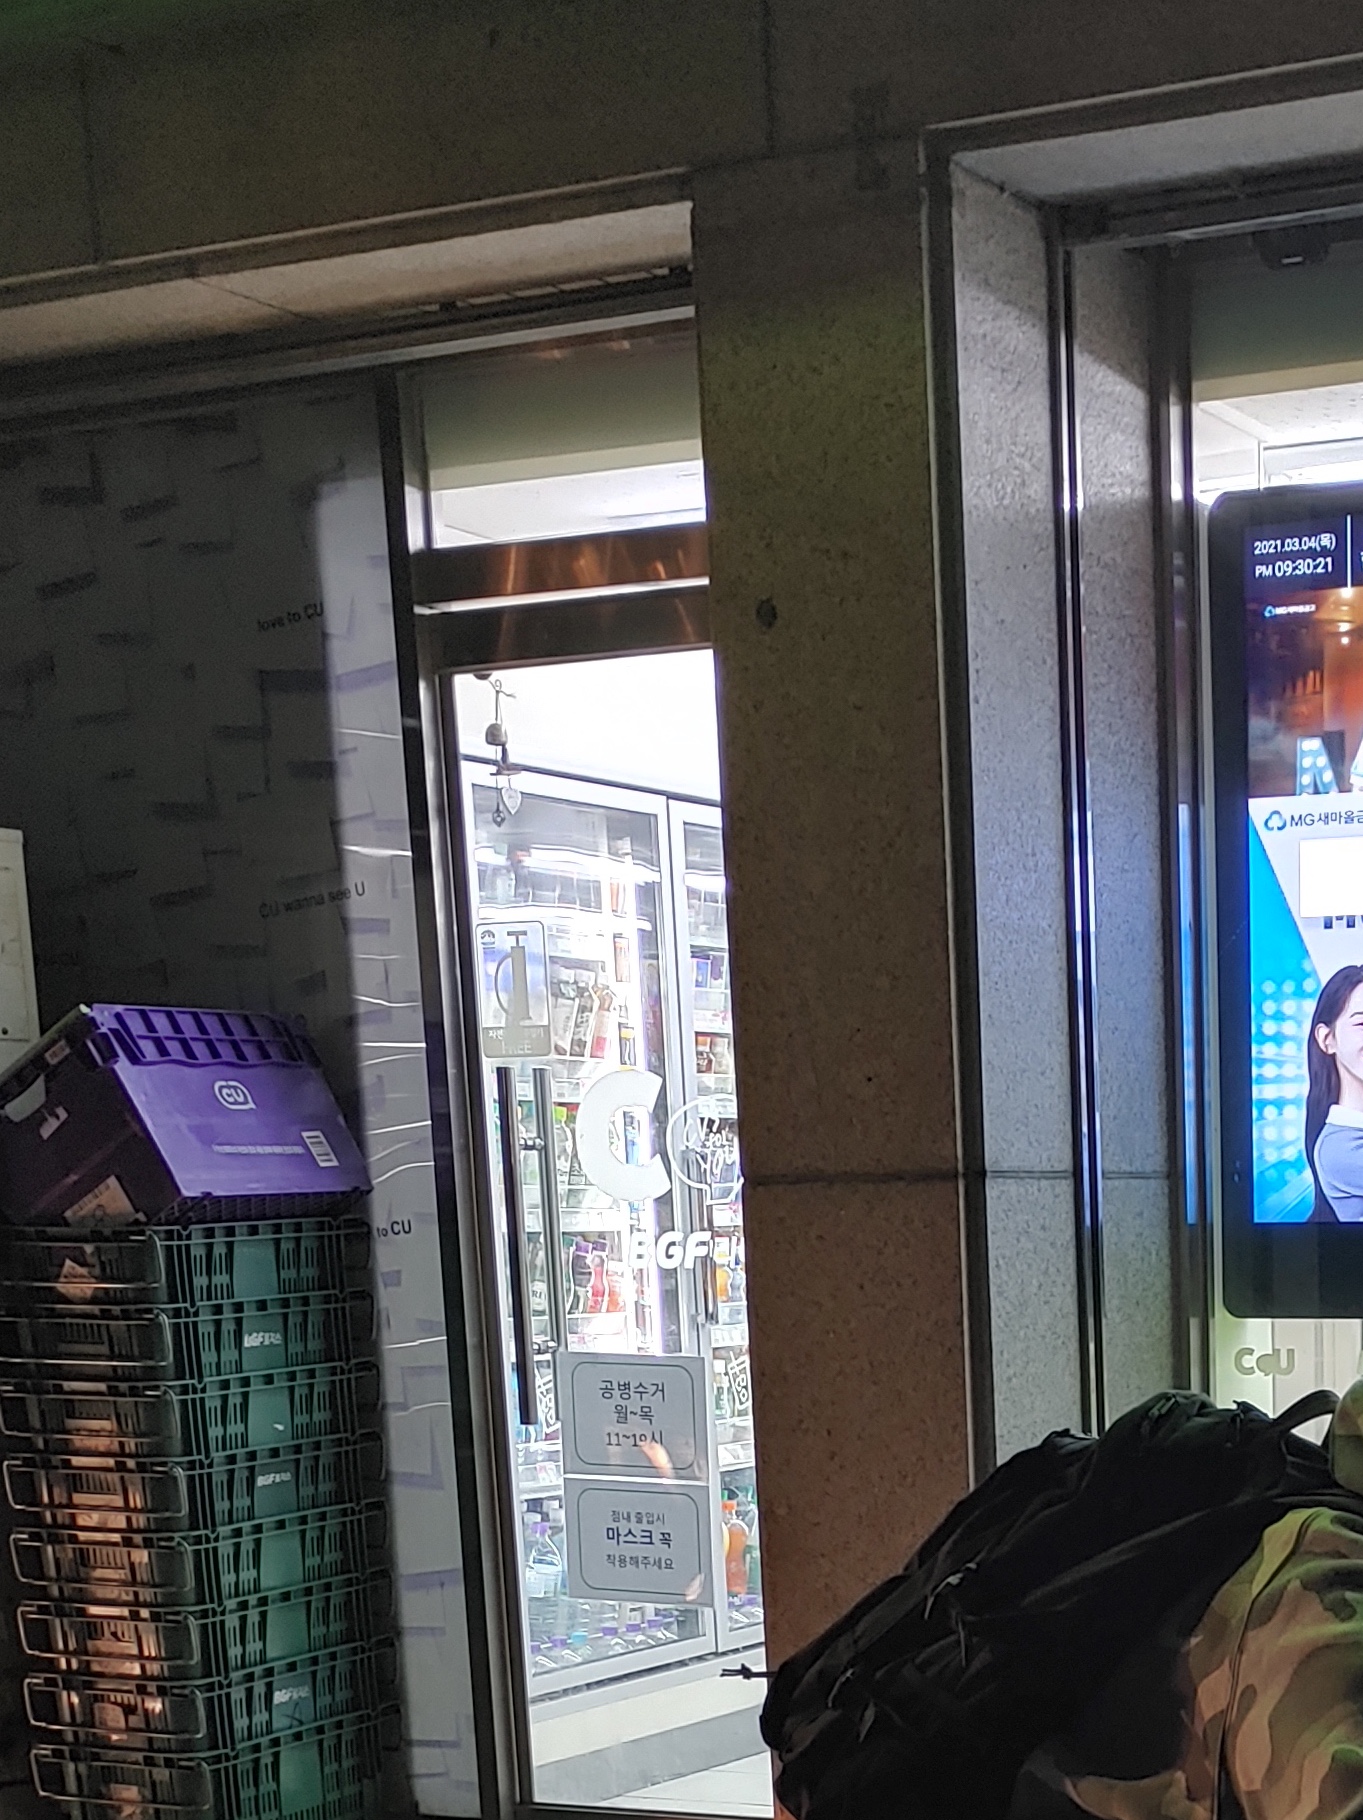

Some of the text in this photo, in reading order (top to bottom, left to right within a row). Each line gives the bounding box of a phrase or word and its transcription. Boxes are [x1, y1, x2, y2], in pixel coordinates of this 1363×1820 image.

[1254, 532, 1337, 555] 2021.03.04(목)
[1255, 556, 1333, 578] PM 09:30:21
[221, 1087, 245, 1103] CU
[390, 1218, 412, 1236] CU
[1234, 1347, 1296, 1377] CU
[598, 1379, 667, 1402] 공병수거
[613, 1404, 655, 1425] 월~목
[610, 1509, 666, 1526] 점내 출입시
[606, 1526, 673, 1549] 마스크 꼭
[605, 1554, 675, 1570] 착용해주세요
